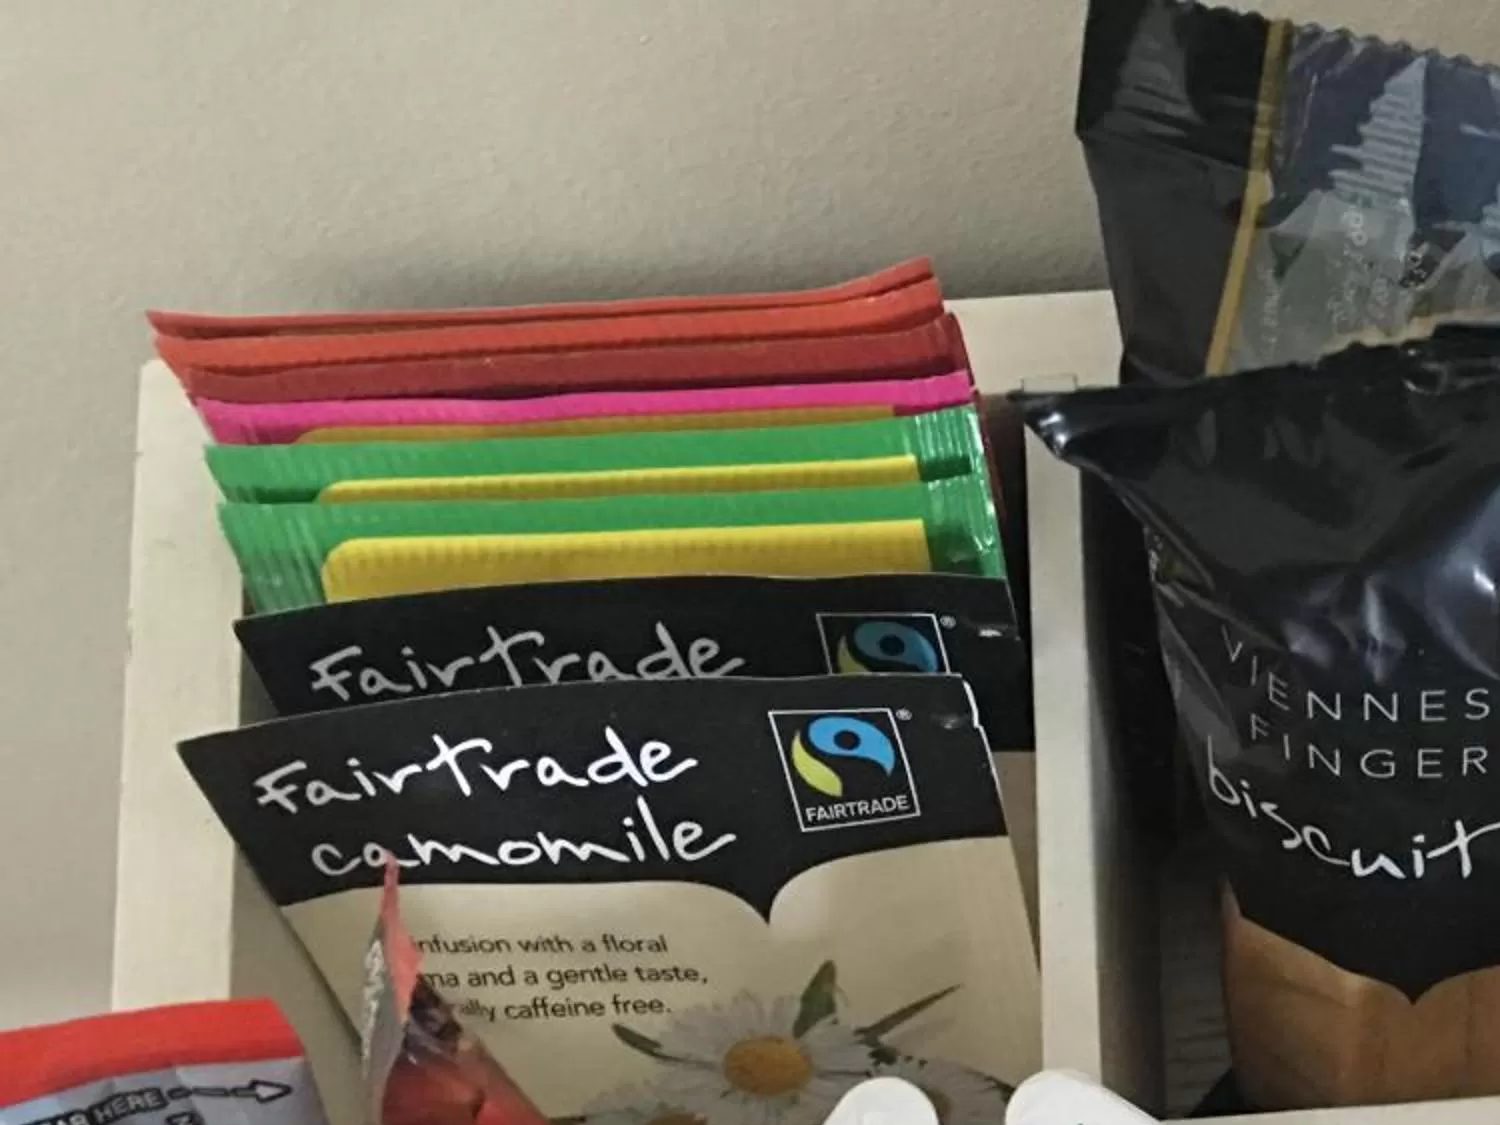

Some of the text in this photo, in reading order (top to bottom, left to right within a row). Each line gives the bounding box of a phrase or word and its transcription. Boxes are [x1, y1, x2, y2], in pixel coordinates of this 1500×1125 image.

[310, 622, 746, 701] Fairtrade
[1250, 712, 1491, 779] FINGER
[254, 725, 698, 817] Fairtrade
[805, 794, 911, 822] FAIRTRADE
[310, 798, 737, 878] camomile
[412, 933, 668, 954] nfusion with a floral
[468, 964, 515, 986] and
[523, 973, 539, 985] a
[546, 964, 627, 990] gentle
[634, 966, 708, 985] taste,
[505, 997, 605, 1021] caffeine
[612, 993, 672, 1014] free.
[94, 1090, 161, 1125] HERE
